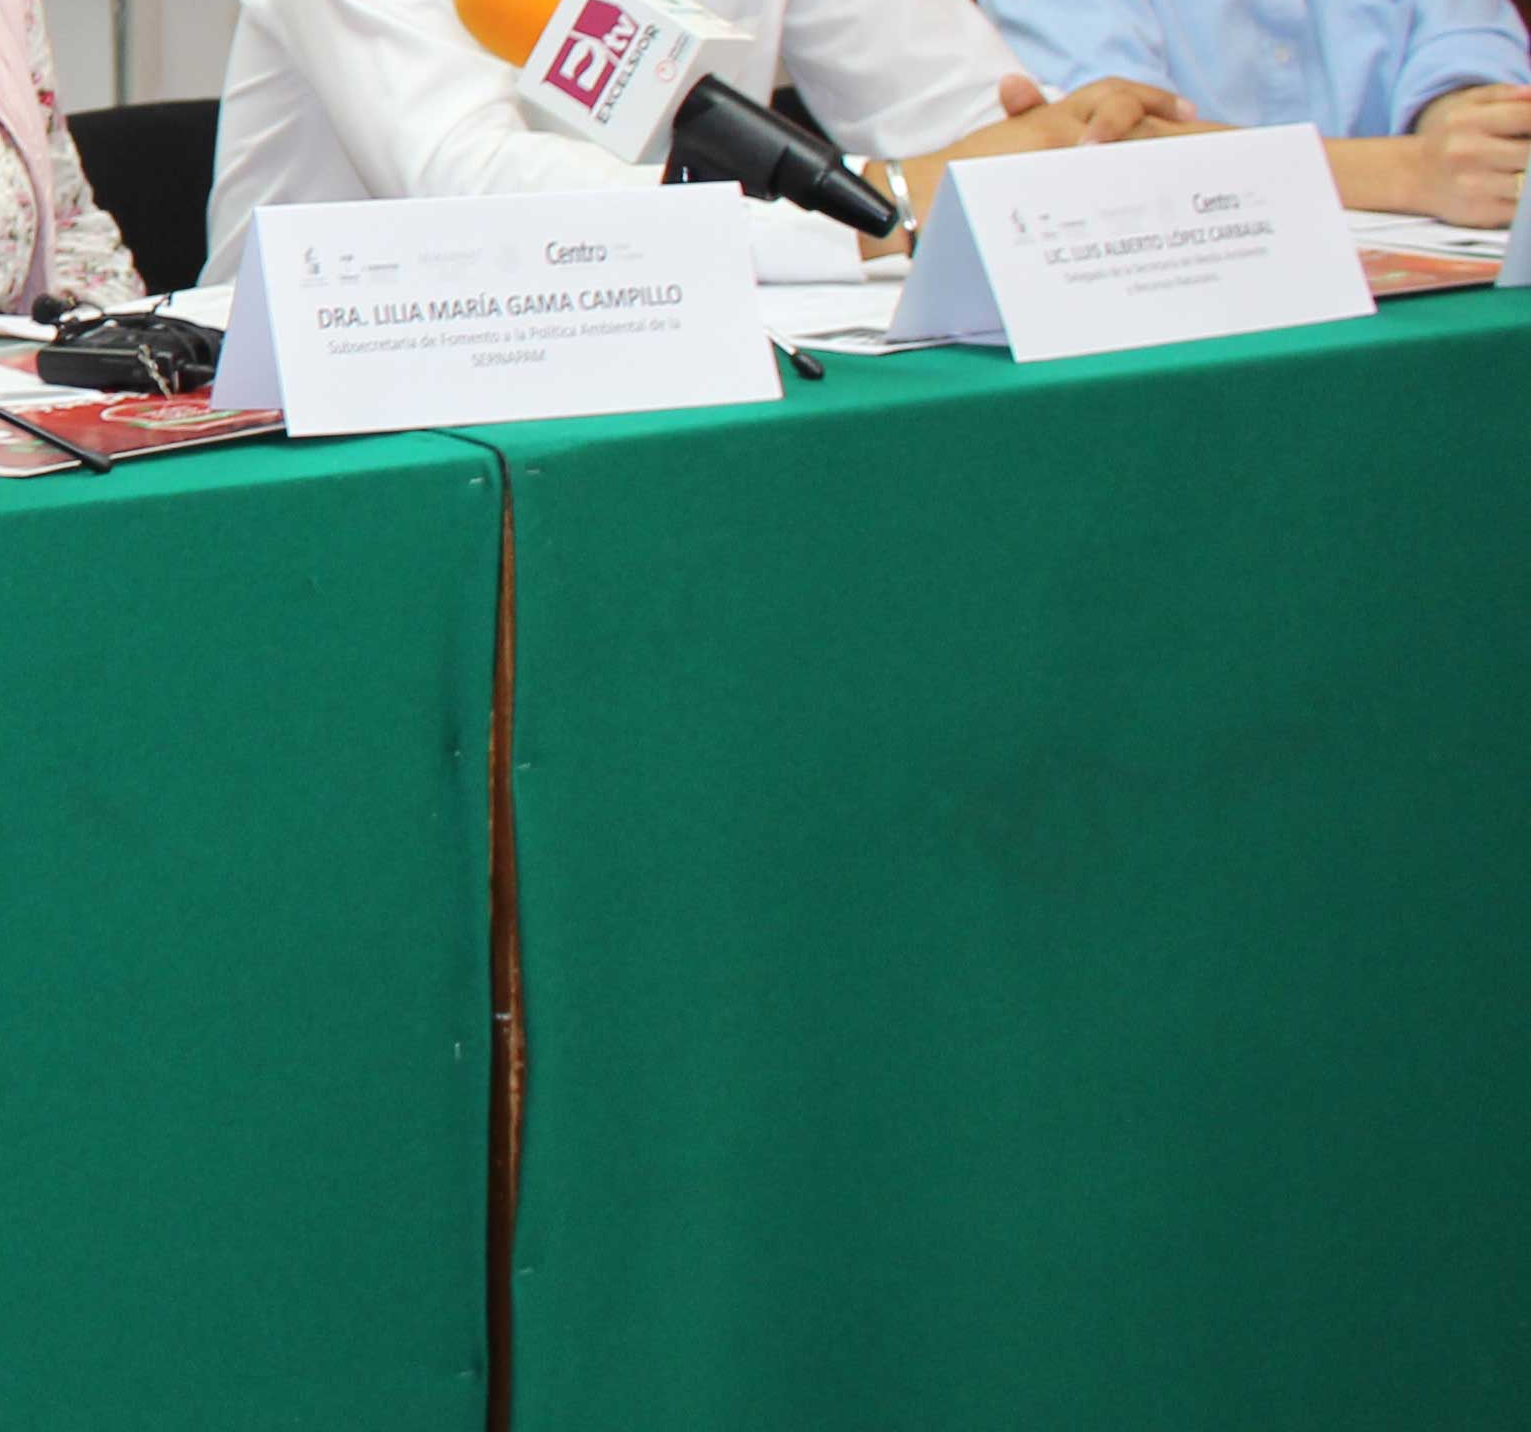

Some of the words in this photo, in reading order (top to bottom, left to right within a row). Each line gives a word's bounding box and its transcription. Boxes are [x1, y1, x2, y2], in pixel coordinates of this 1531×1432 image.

[544, 240, 607, 267] Centro
[316, 306, 369, 330] DRA.
[373, 301, 425, 326] LILIA
[428, 291, 501, 322] MARÍA
[506, 288, 571, 316] GAMA
[578, 282, 683, 312] CAMPILLO
